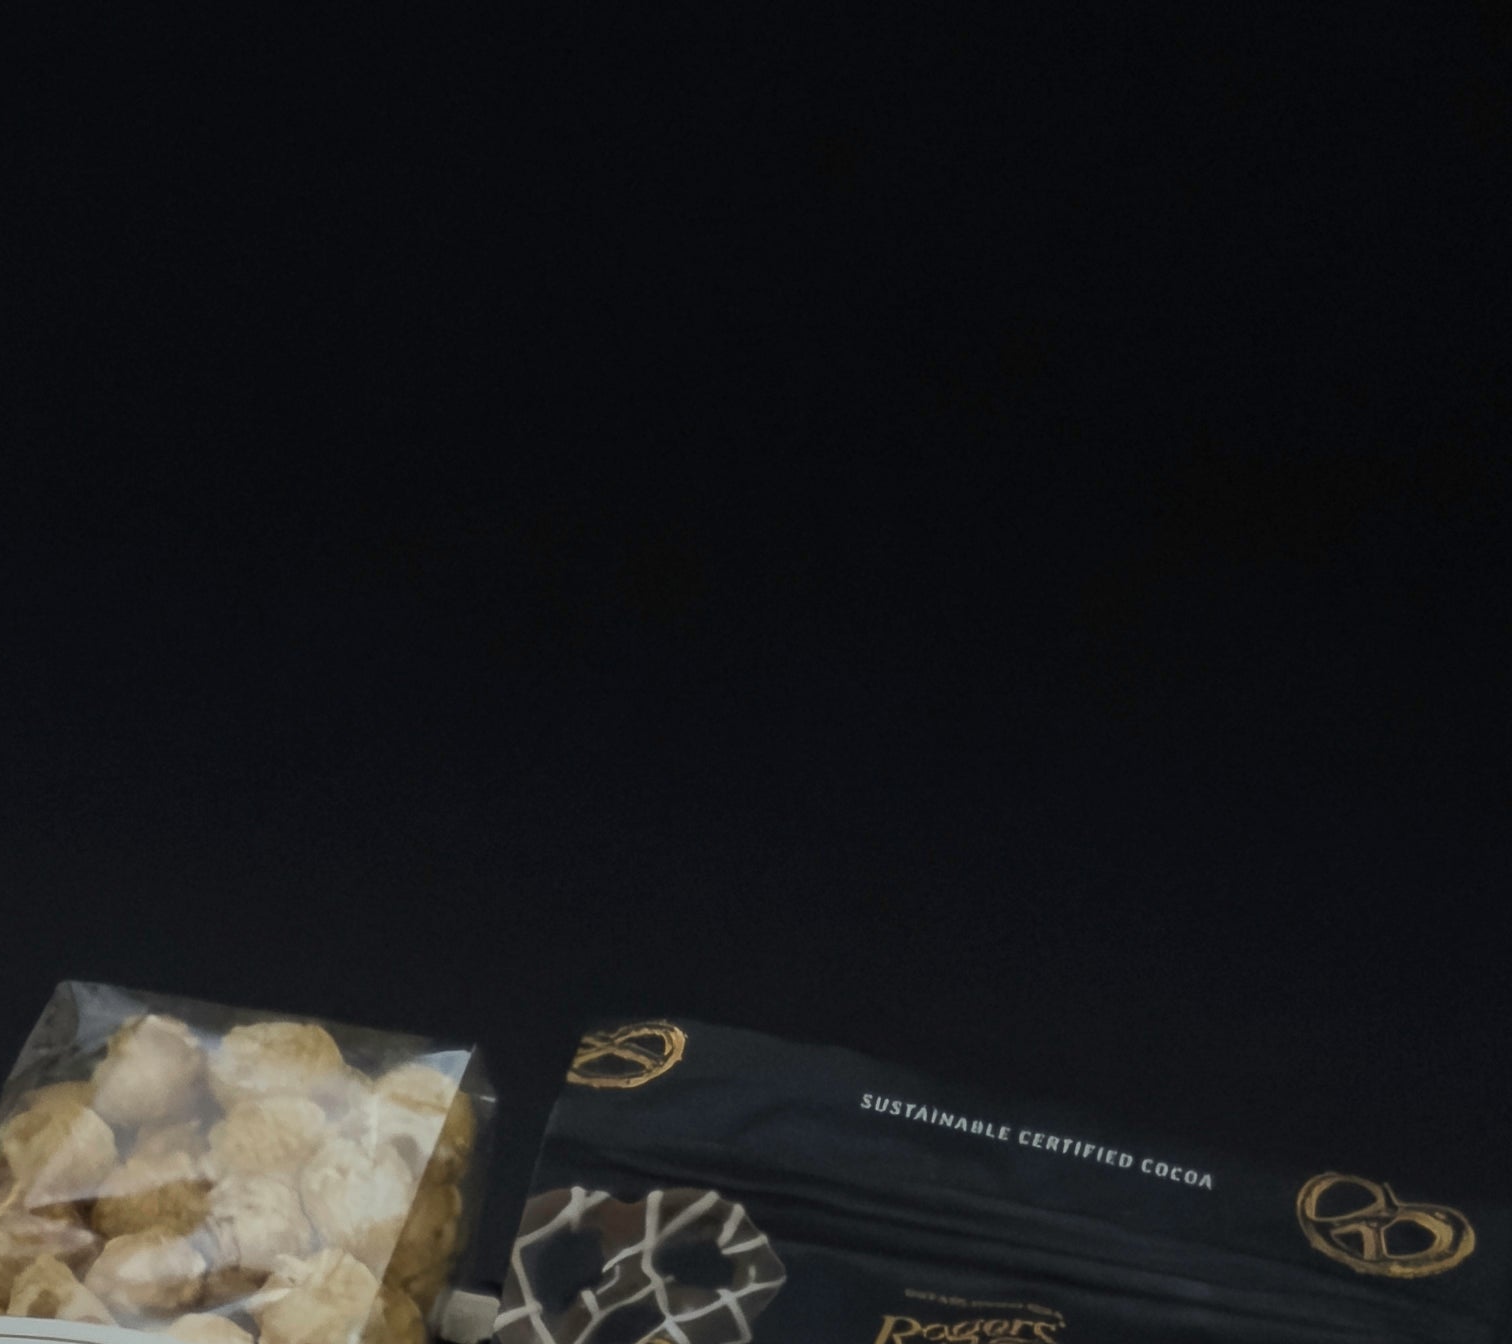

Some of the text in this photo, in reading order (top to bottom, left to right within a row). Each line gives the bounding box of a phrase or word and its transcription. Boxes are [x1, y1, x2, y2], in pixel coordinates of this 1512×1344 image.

[860, 1093, 1213, 1191] SUSTAINABLE CERTIFIED COCOA
